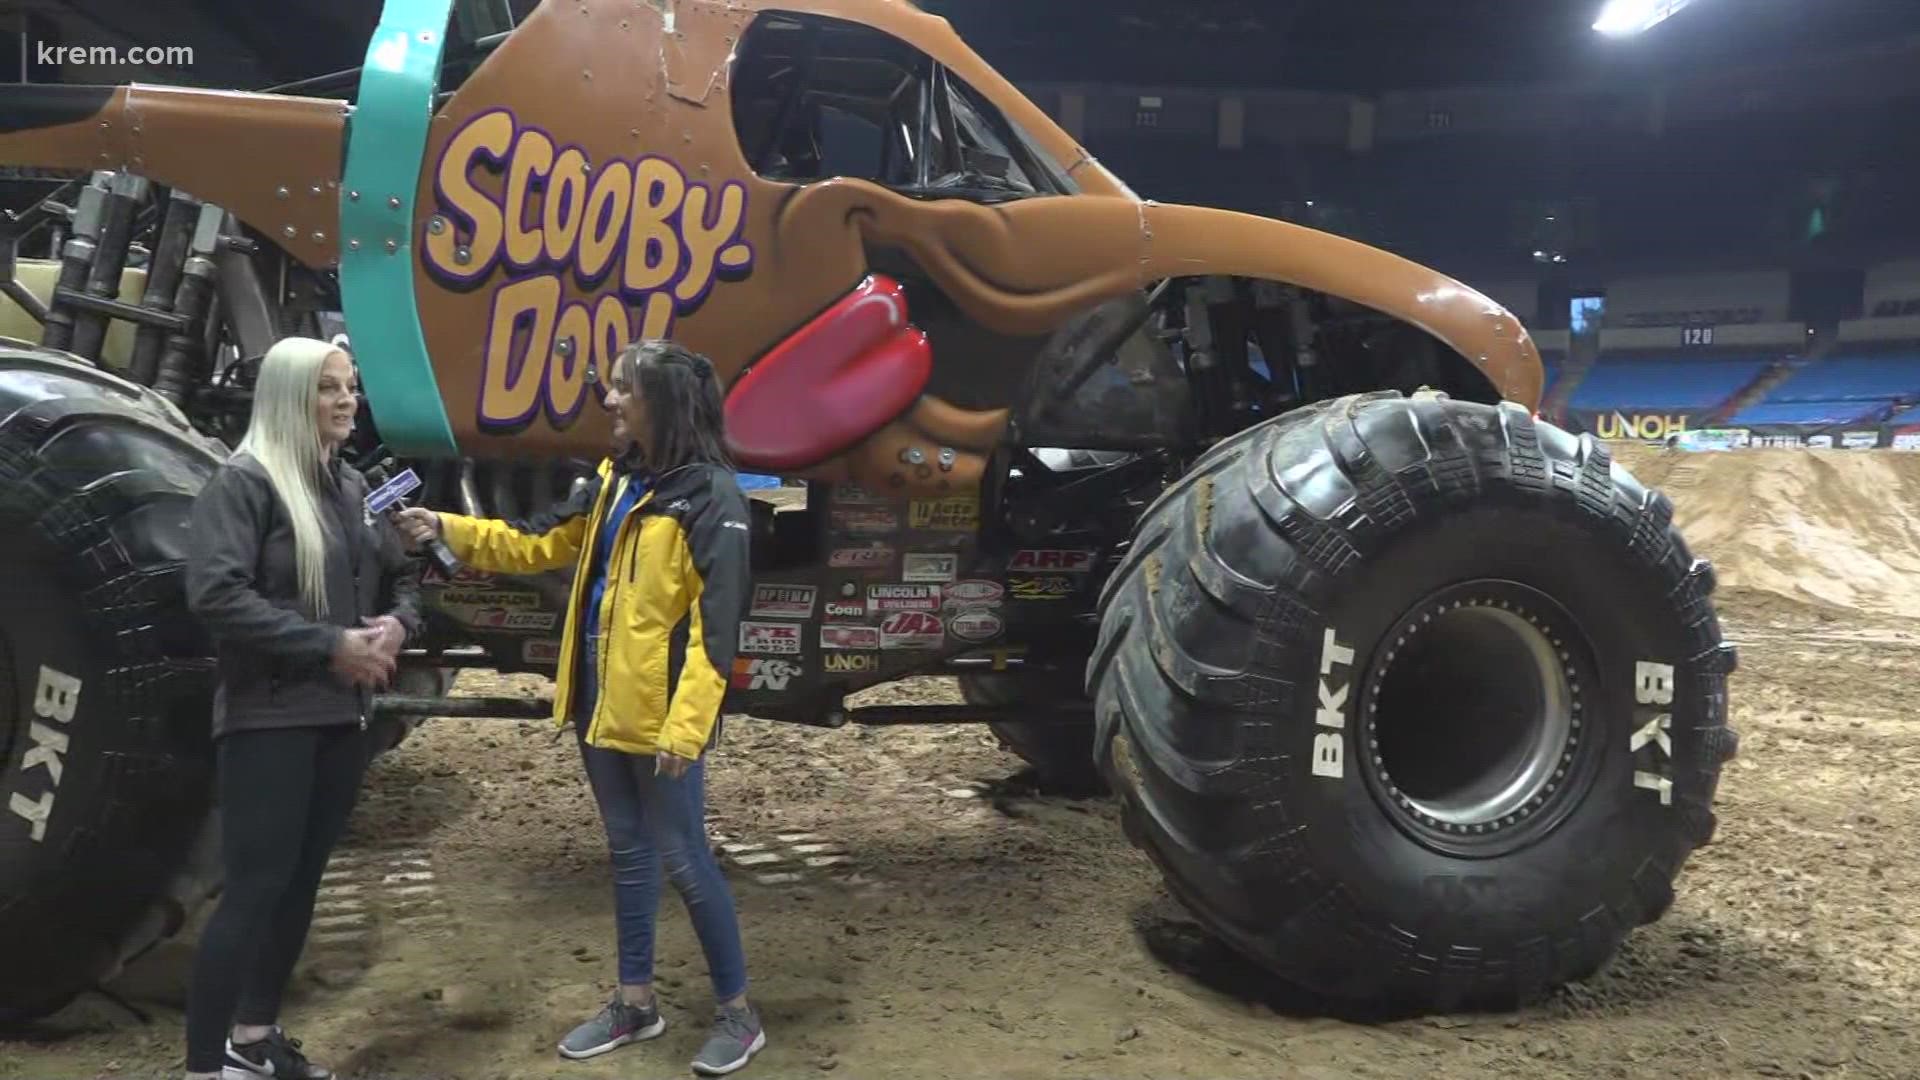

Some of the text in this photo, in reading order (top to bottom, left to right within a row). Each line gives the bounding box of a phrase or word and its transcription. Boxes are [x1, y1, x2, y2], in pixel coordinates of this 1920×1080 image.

[1684, 328, 1713, 344] 120
[1597, 414, 1686, 440] UNOH
[1012, 551, 1088, 568] ARP
[759, 589, 811, 603] OPTIMA
[871, 587, 928, 598] LINCOLN
[825, 602, 863, 616] Coan
[825, 654, 879, 670] UNOH
[1312, 627, 1355, 779] BKT
[1629, 660, 1675, 806] BKT
[9, 663, 83, 843] BKT
